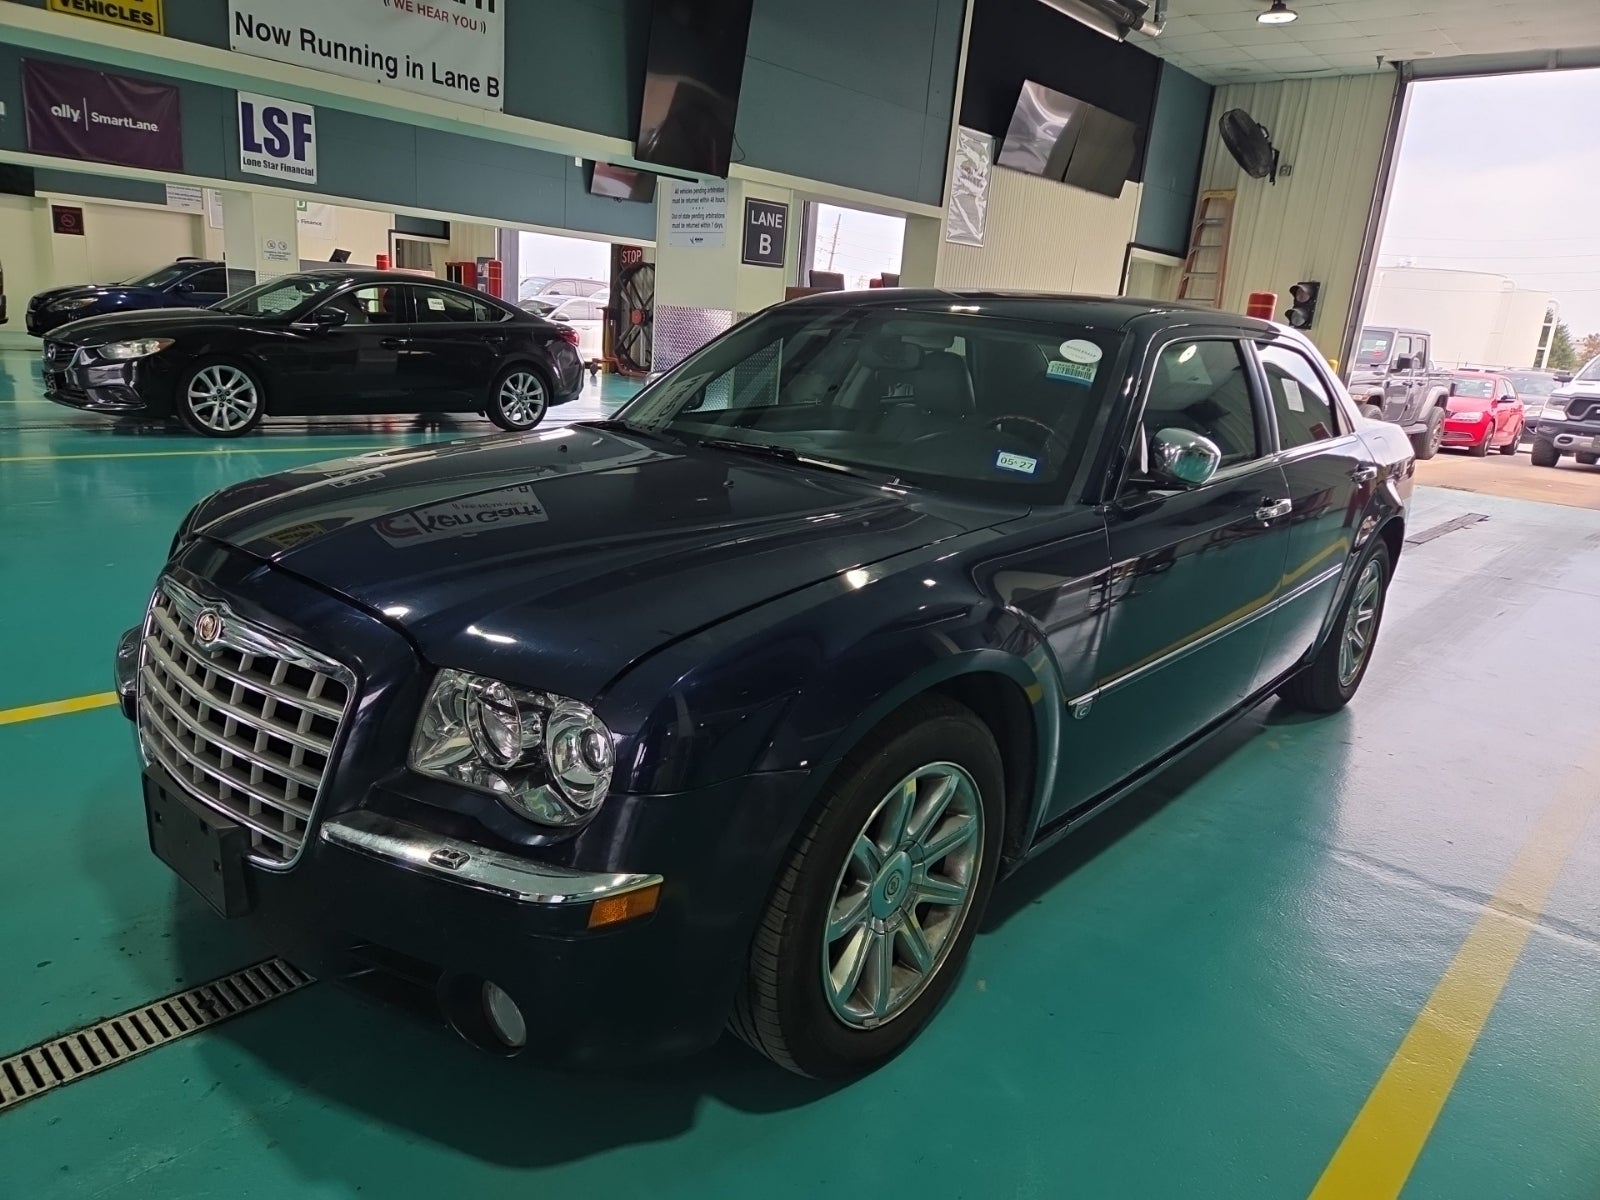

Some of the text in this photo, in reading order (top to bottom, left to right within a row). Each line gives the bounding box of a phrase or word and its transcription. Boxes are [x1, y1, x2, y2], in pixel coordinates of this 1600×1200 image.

[393, 0, 414, 12] WE
[417, 3, 449, 23] HEAR
[452, 14, 477, 31] YOU
[235, 11, 500, 98] Now Running in Lane B
[50, 103, 81, 123] ally
[91, 112, 159, 132] SmartLane
[240, 101, 312, 162] LSF
[243, 156, 314, 177] Lone Star Financial
[751, 209, 783, 229] LANE
[759, 233, 772, 255] B
[622, 249, 642, 263] STOP
[1000, 456, 1034, 470] 05 27
